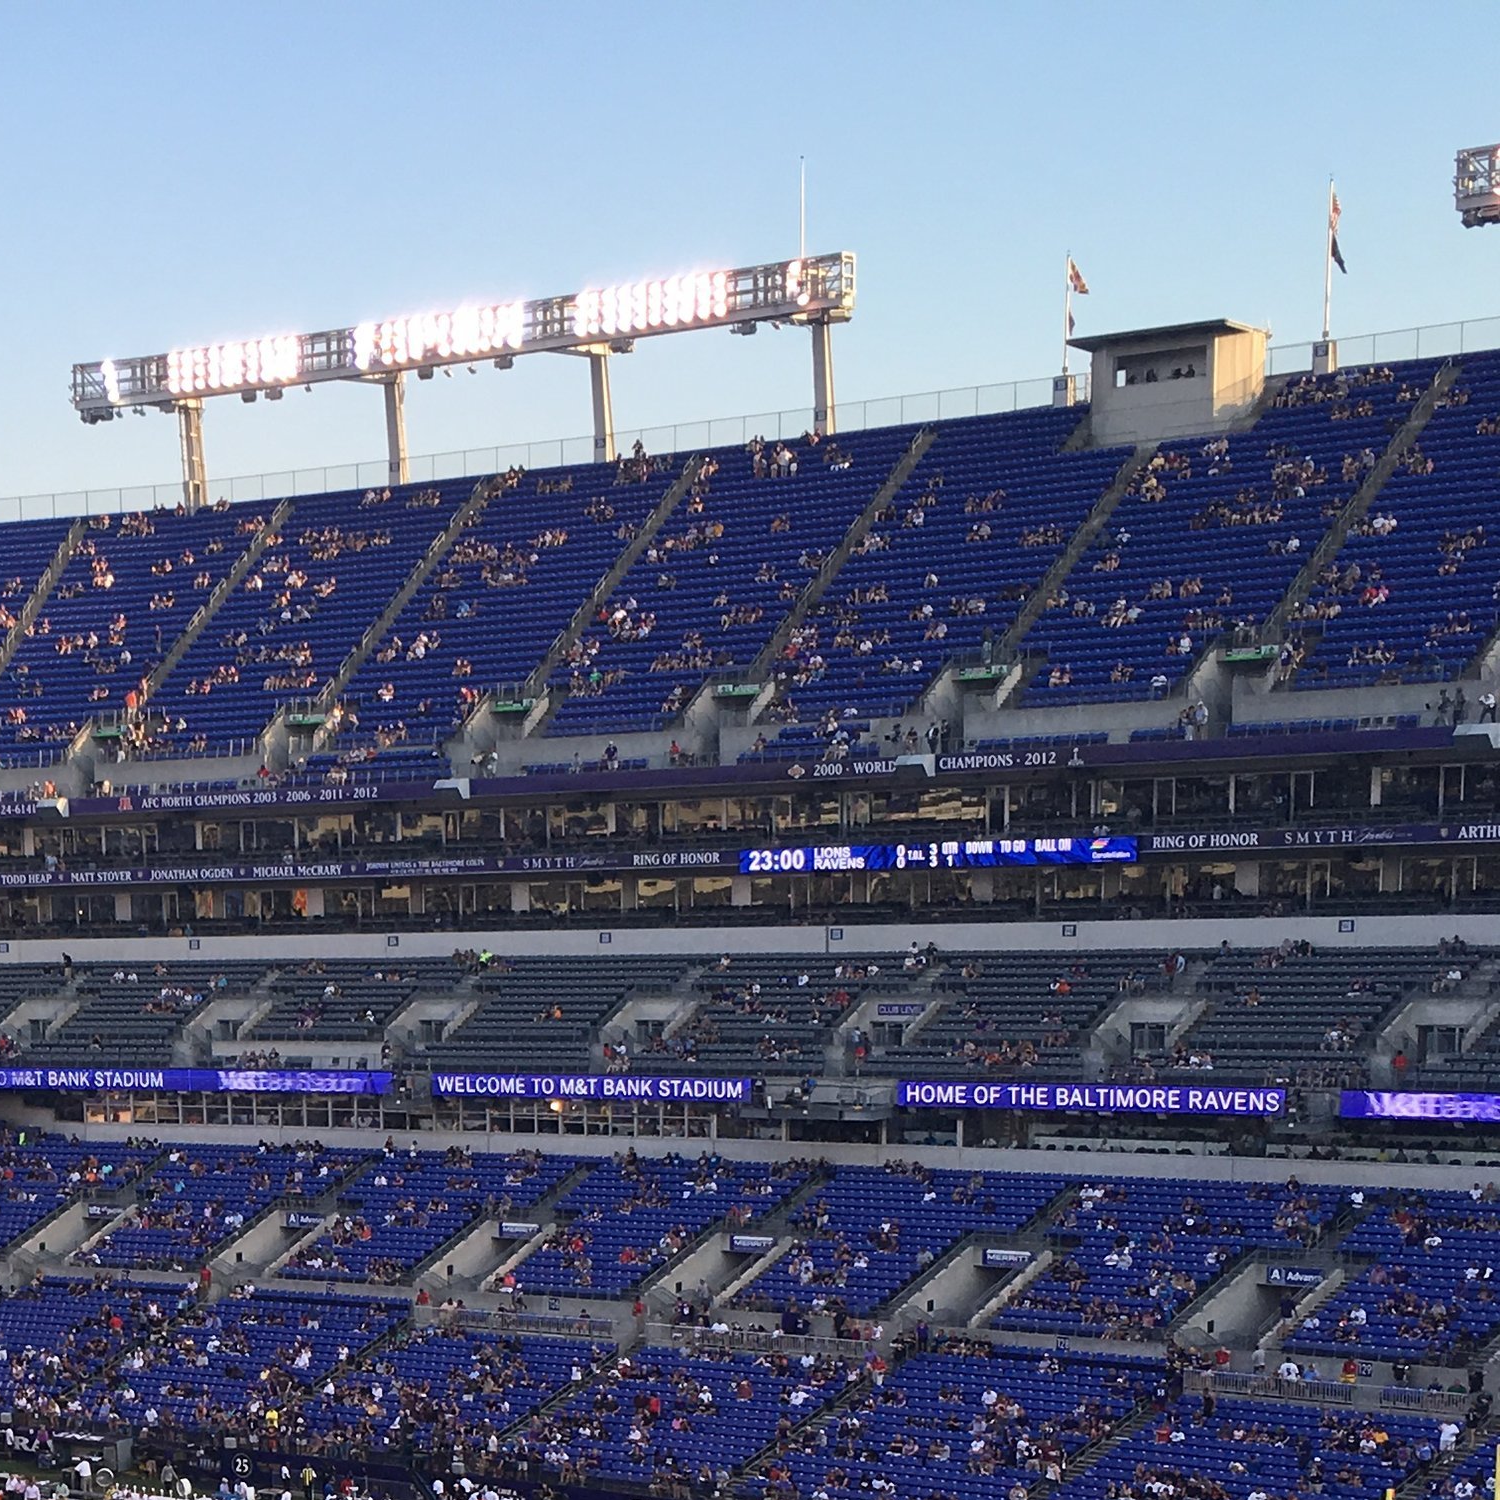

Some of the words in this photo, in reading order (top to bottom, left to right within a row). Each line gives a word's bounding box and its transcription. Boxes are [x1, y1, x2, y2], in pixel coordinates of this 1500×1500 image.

[813, 764, 843, 776] 2000
[854, 761, 897, 774] WORLD
[939, 754, 1013, 770] CHAMPIONS
[1025, 752, 1056, 766] 2012
[141, 797, 159, 809] AFC
[161, 796, 192, 808] NORTH
[194, 793, 250, 807] CHAMPIONS
[253, 792, 277, 803] 2003
[286, 790, 310, 802] 2006
[320, 789, 342, 801] 2011
[353, 787, 378, 799] 2012
[929, 843, 938, 855] 3
[942, 841, 959, 855] QTR
[965, 840, 993, 854] DOWN
[1000, 840, 1012, 853] TO
[1013, 840, 1026, 853] GO
[1035, 838, 1057, 852] BALL
[1152, 836, 1185, 849] RING
[1188, 835, 1206, 847] OF
[1209, 833, 1259, 847] HONOR
[633, 853, 659, 866] RING
[662, 852, 677, 864] OF
[679, 851, 720, 864] HONOR
[749, 849, 805, 871] 23:00
[814, 847, 851, 859] LIONS
[896, 845, 906, 857] 0
[814, 858, 865, 870] RAVENS
[896, 857, 906, 869] 0
[929, 855, 938, 867] 3
[946, 855, 953, 866] 1
[1, 874, 27, 886] TODD
[28, 873, 52, 884] HEAP
[70, 872, 96, 883] MATT
[150, 869, 198, 881] JONATHAN
[200, 867, 233, 879] OGDEN
[253, 866, 295, 878] MICHAEL
[298, 864, 342, 877] McCRARY
[11, 1071, 44, 1086] M&T
[48, 1071, 90, 1087] BANK
[94, 1071, 164, 1088] STADIUM
[437, 1075, 526, 1095] WELCOME
[532, 1077, 554, 1096] TO
[559, 1077, 598, 1096] M&T
[604, 1077, 653, 1098] BANK
[658, 1078, 744, 1100] STADIUM!
[905, 1083, 967, 1105] HOME
[973, 1084, 1001, 1106] OF
[1007, 1085, 1049, 1107] THE
[1055, 1086, 1181, 1110] BALTIMORE
[1188, 1089, 1281, 1112] RAVENS
[235, 1457, 249, 1473] 25
